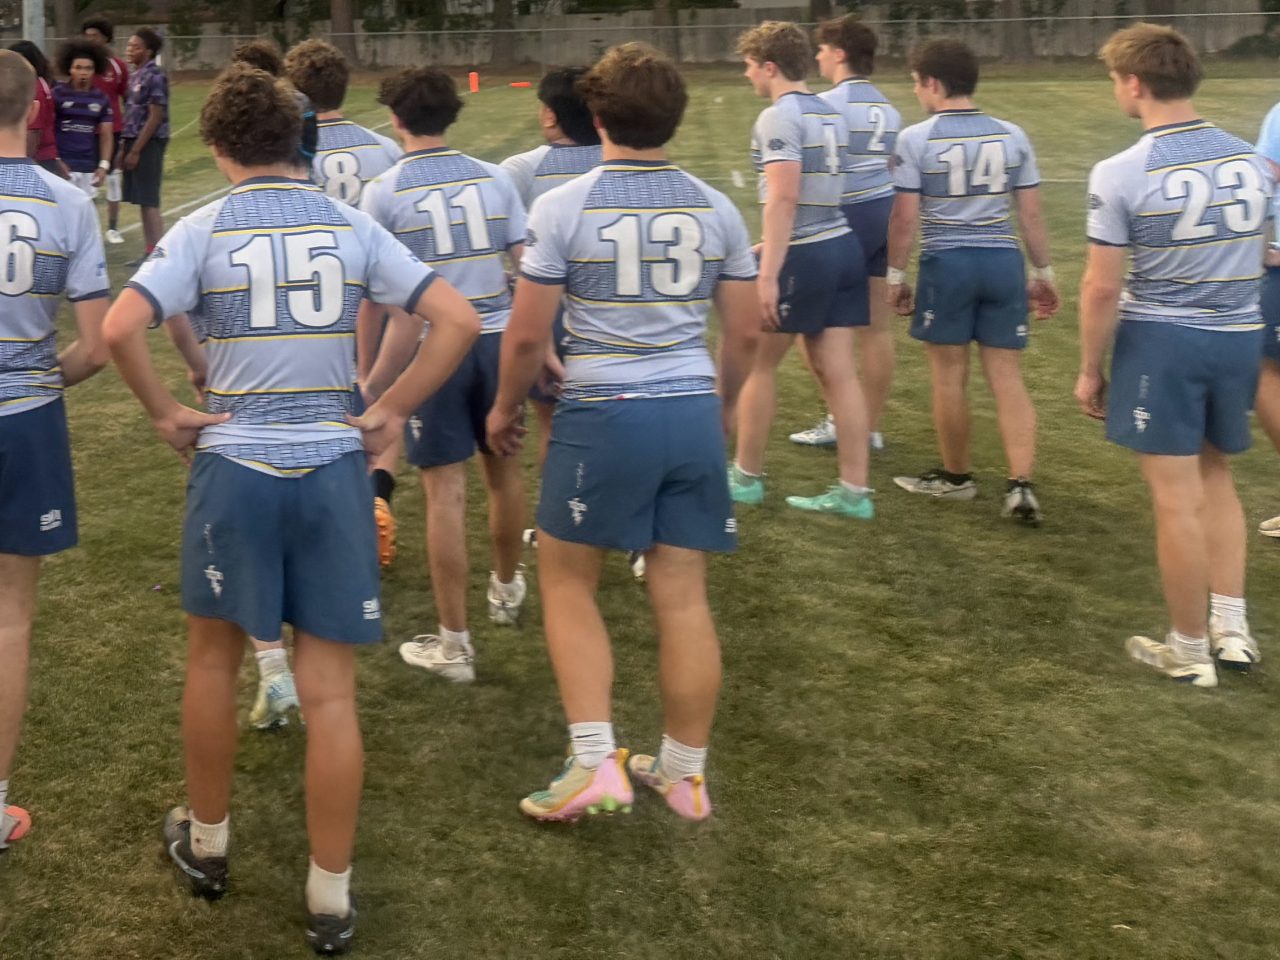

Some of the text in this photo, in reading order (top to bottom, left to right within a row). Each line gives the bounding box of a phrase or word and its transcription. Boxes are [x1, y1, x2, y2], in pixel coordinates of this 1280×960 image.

[867, 105, 887, 152] 2
[321, 151, 361, 206] 8
[937, 140, 1008, 197] 14
[1162, 159, 1266, 240] 23
[414, 184, 490, 256] 11
[598, 212, 704, 297] 13
[229, 230, 345, 329] 15
